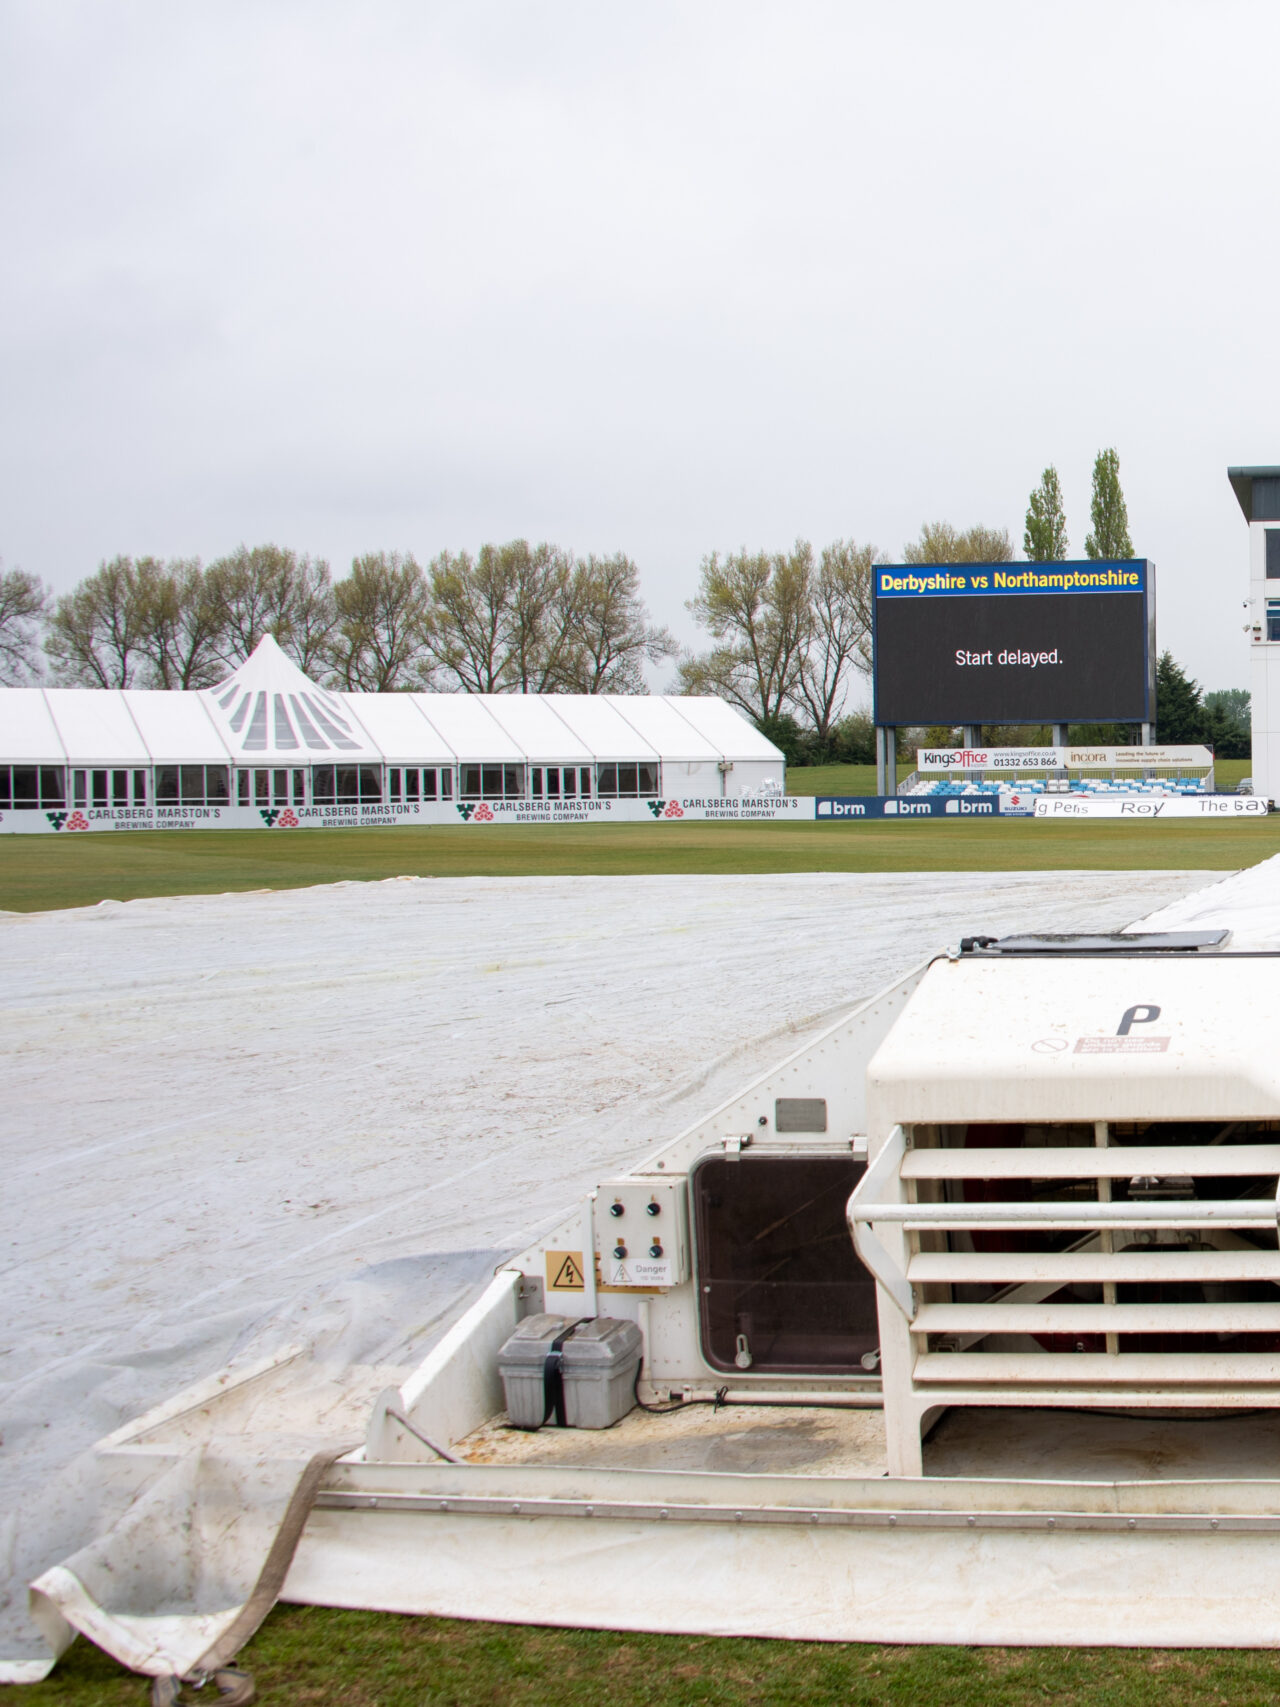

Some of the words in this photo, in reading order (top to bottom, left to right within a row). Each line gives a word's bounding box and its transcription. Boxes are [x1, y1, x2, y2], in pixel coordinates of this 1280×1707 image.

[881, 573, 966, 593] Derbyshire
[971, 576, 989, 589] vs
[994, 570, 1139, 590] Northamptonshire
[955, 650, 993, 666] Start
[998, 648, 1063, 668] delayed.
[994, 758, 1021, 767] 01332
[1022, 758, 1039, 766] 653
[1041, 757, 1057, 766] 866
[1071, 751, 1107, 763] incora
[493, 802, 550, 812] CARLSBERG
[554, 800, 612, 811] MARSTON'S
[683, 799, 739, 808] CARLSBERG
[742, 798, 798, 808] MARSTON'S
[833, 801, 866, 815] brm
[900, 800, 931, 814] brm
[960, 799, 993, 813] brm
[1198, 800, 1228, 812] The
[88, 808, 154, 820] CARLSBERG
[157, 808, 221, 819] MARSTON'S
[298, 806, 358, 817] CARLSBERG
[362, 804, 420, 815] MARSTON'S
[516, 813, 550, 821] BREWING
[553, 812, 589, 820] COMPANY
[705, 810, 739, 818] BREWING
[741, 810, 776, 818] COMPANY
[115, 821, 153, 830] BREWING
[156, 820, 195, 829] COMPANY
[322, 818, 358, 826] BREWING
[361, 817, 397, 825] COMPANY
[635, 1265, 667, 1274] Danger
